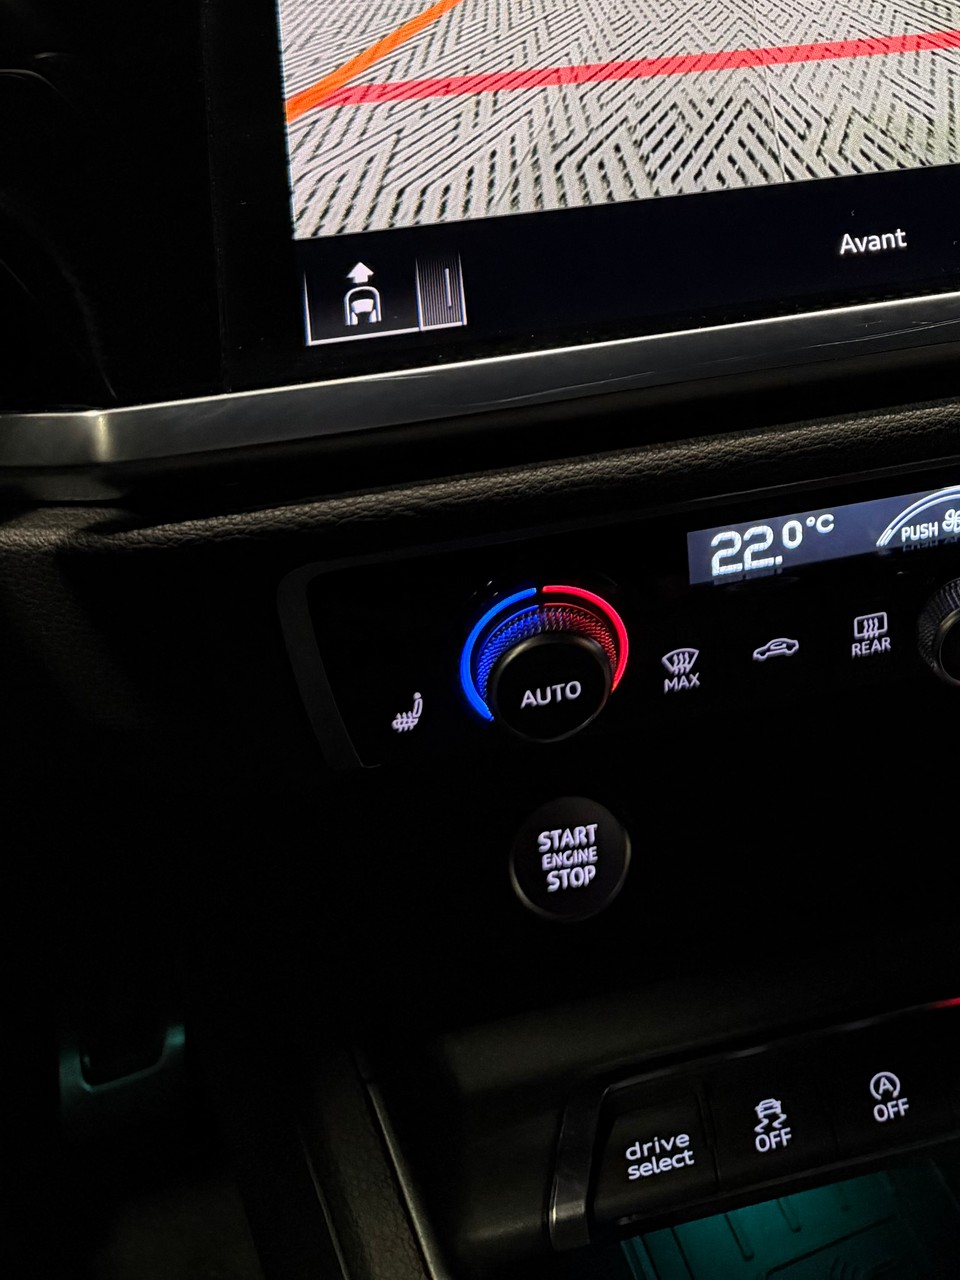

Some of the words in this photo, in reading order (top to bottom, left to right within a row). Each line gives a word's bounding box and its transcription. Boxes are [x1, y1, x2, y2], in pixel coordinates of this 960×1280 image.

[839, 228, 908, 255] Avant
[901, 522, 939, 542] PUSH
[851, 634, 891, 657] REAR
[520, 680, 582, 708] AUTO
[663, 672, 700, 693] MAX
[537, 823, 598, 851] START
[541, 846, 598, 871] ENGINE
[546, 867, 597, 892] STOP
[873, 1098, 909, 1123] OFF
[625, 1132, 690, 1161] drive
[754, 1128, 792, 1153] OFF
[627, 1150, 695, 1180] select
